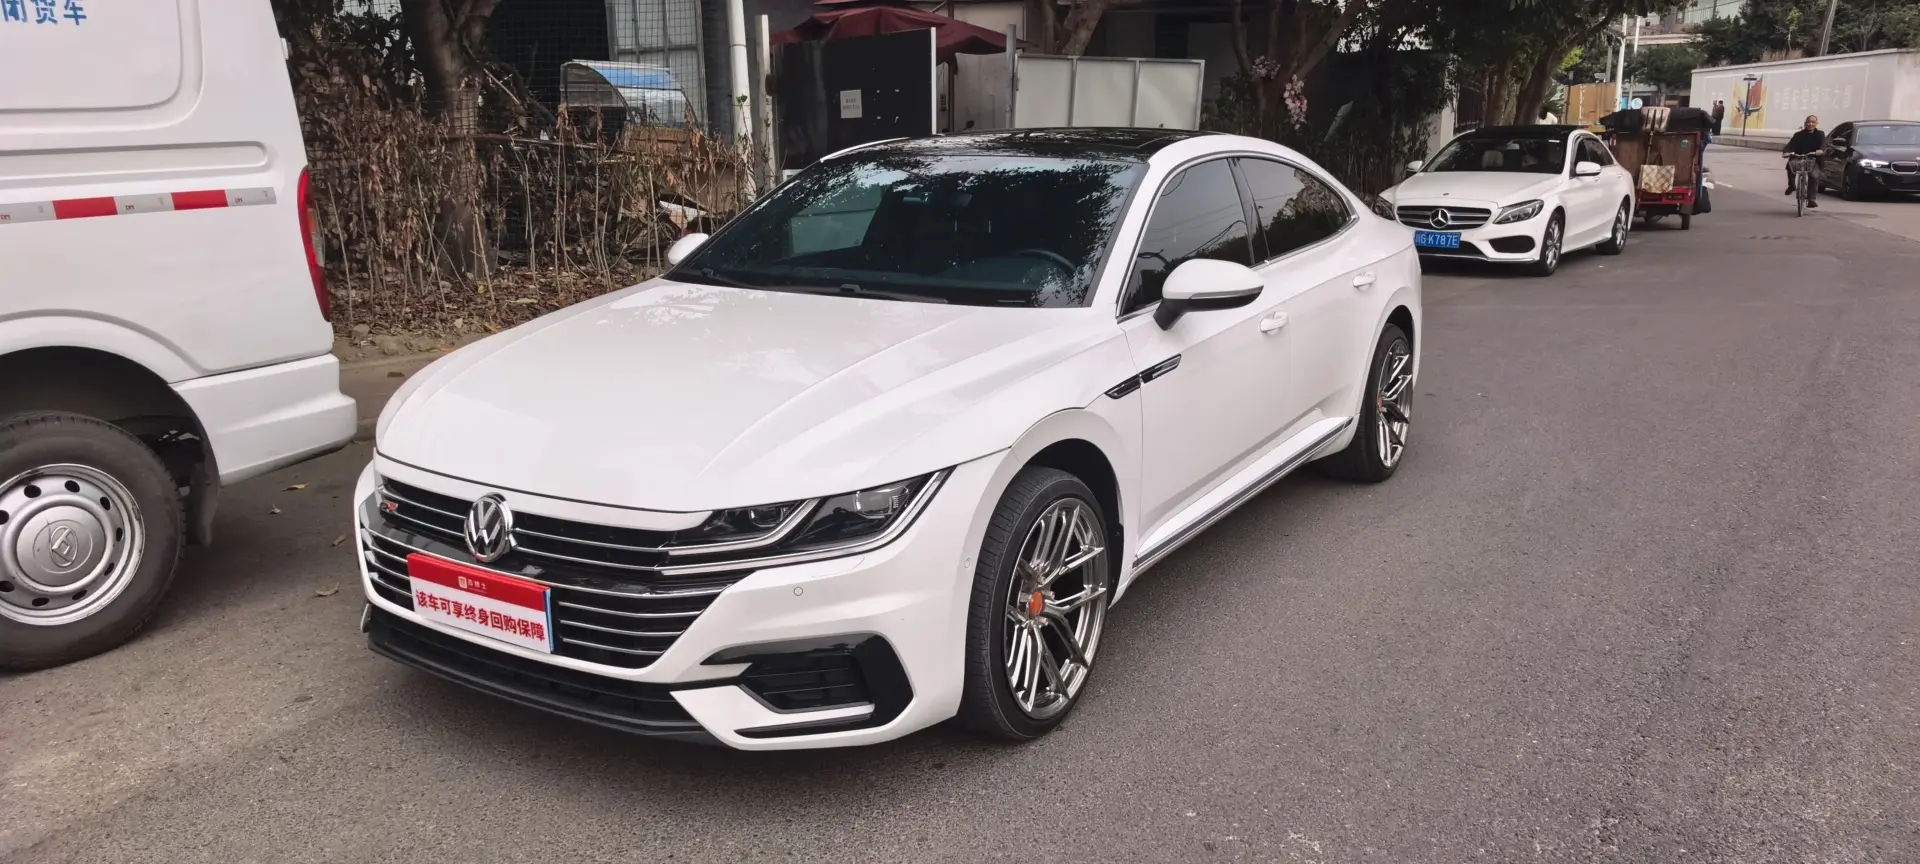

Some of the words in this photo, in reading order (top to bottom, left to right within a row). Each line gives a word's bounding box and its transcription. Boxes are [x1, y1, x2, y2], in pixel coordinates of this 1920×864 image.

[416, 590, 545, 641] 该车可享终身回购保障
